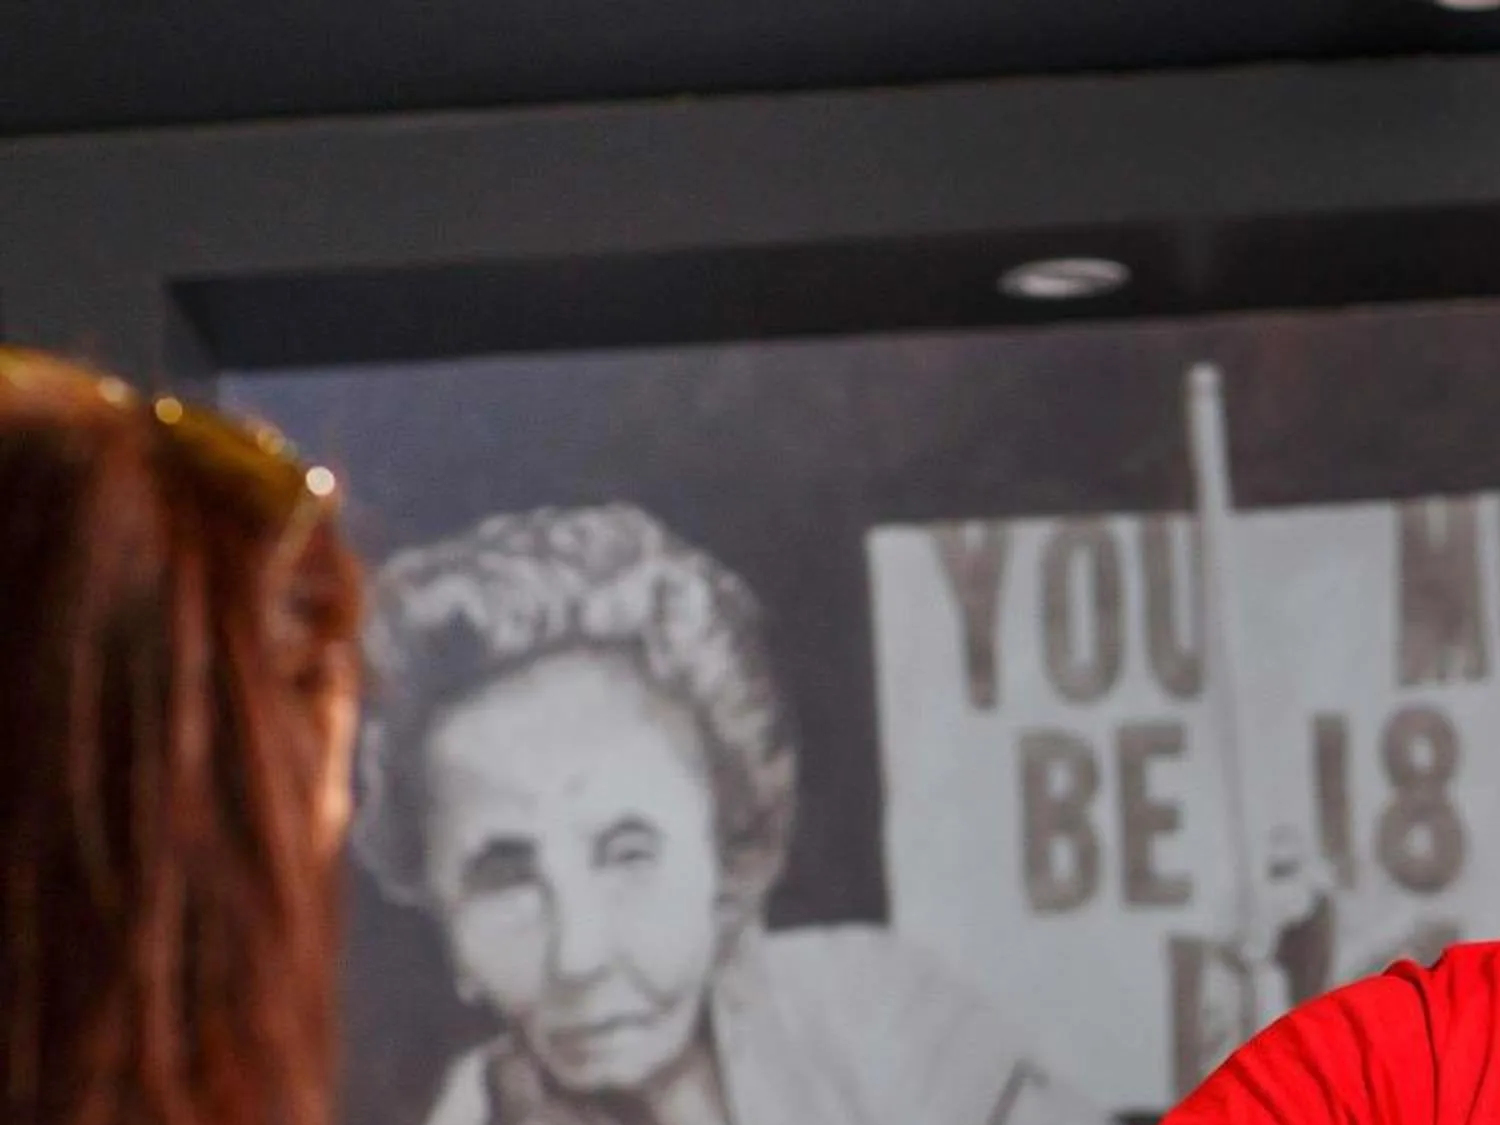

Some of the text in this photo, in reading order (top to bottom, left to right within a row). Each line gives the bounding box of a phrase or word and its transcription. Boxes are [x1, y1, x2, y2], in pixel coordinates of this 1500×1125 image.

[932, 520, 1203, 712] YOU
[1019, 720, 1193, 913] BE
[1311, 706, 1466, 894] 18
